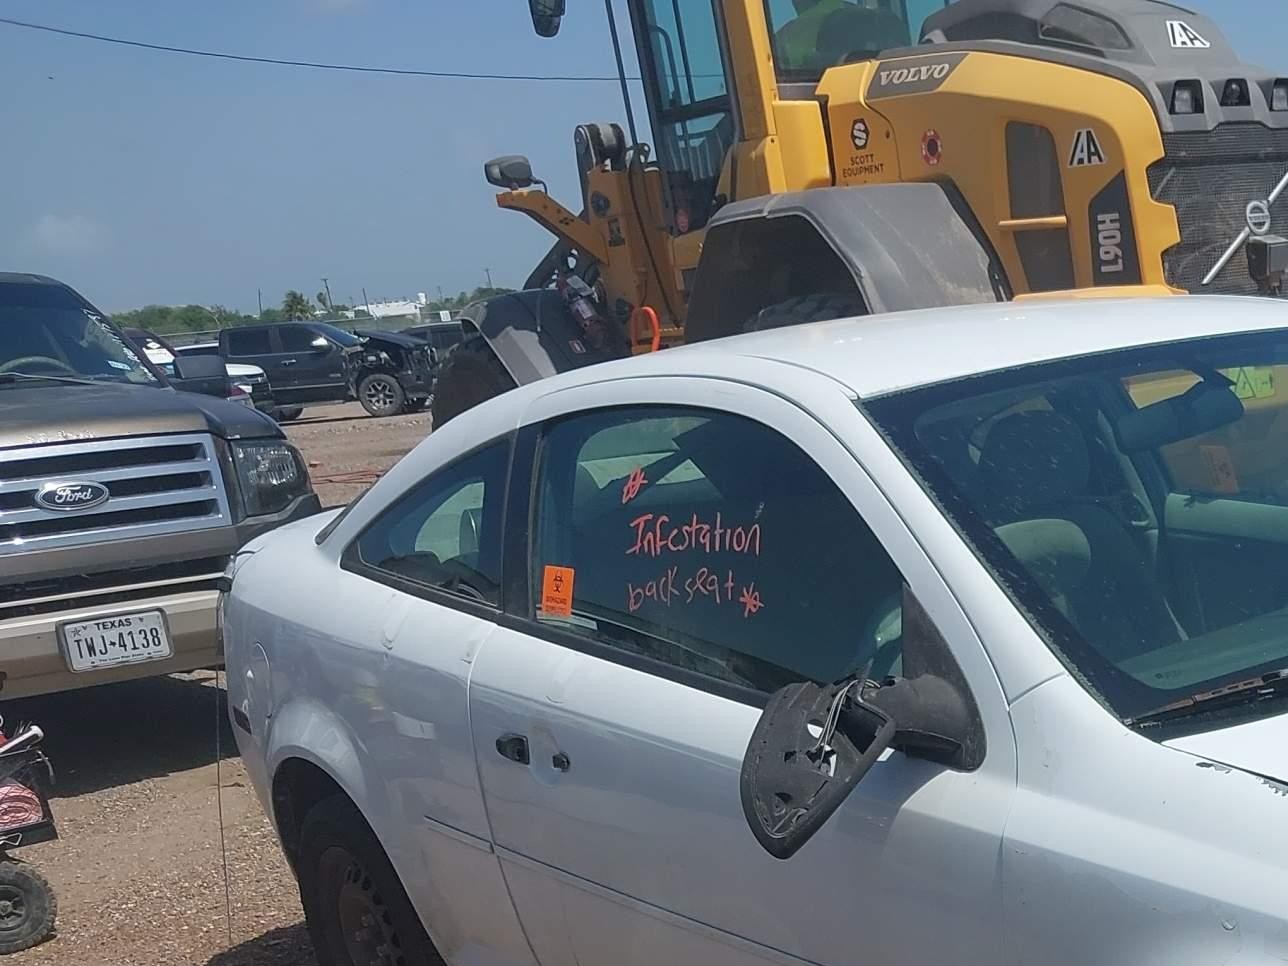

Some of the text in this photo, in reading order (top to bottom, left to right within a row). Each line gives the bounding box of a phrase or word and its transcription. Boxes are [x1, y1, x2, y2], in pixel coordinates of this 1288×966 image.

[880, 63, 949, 86] VOLVO
[850, 153, 874, 166] SCOTT
[842, 163, 884, 178] EQUIPMENT
[1097, 213, 1123, 273] L90H
[55, 485, 93, 503] Ford
[94, 617, 132, 631] TEXAS
